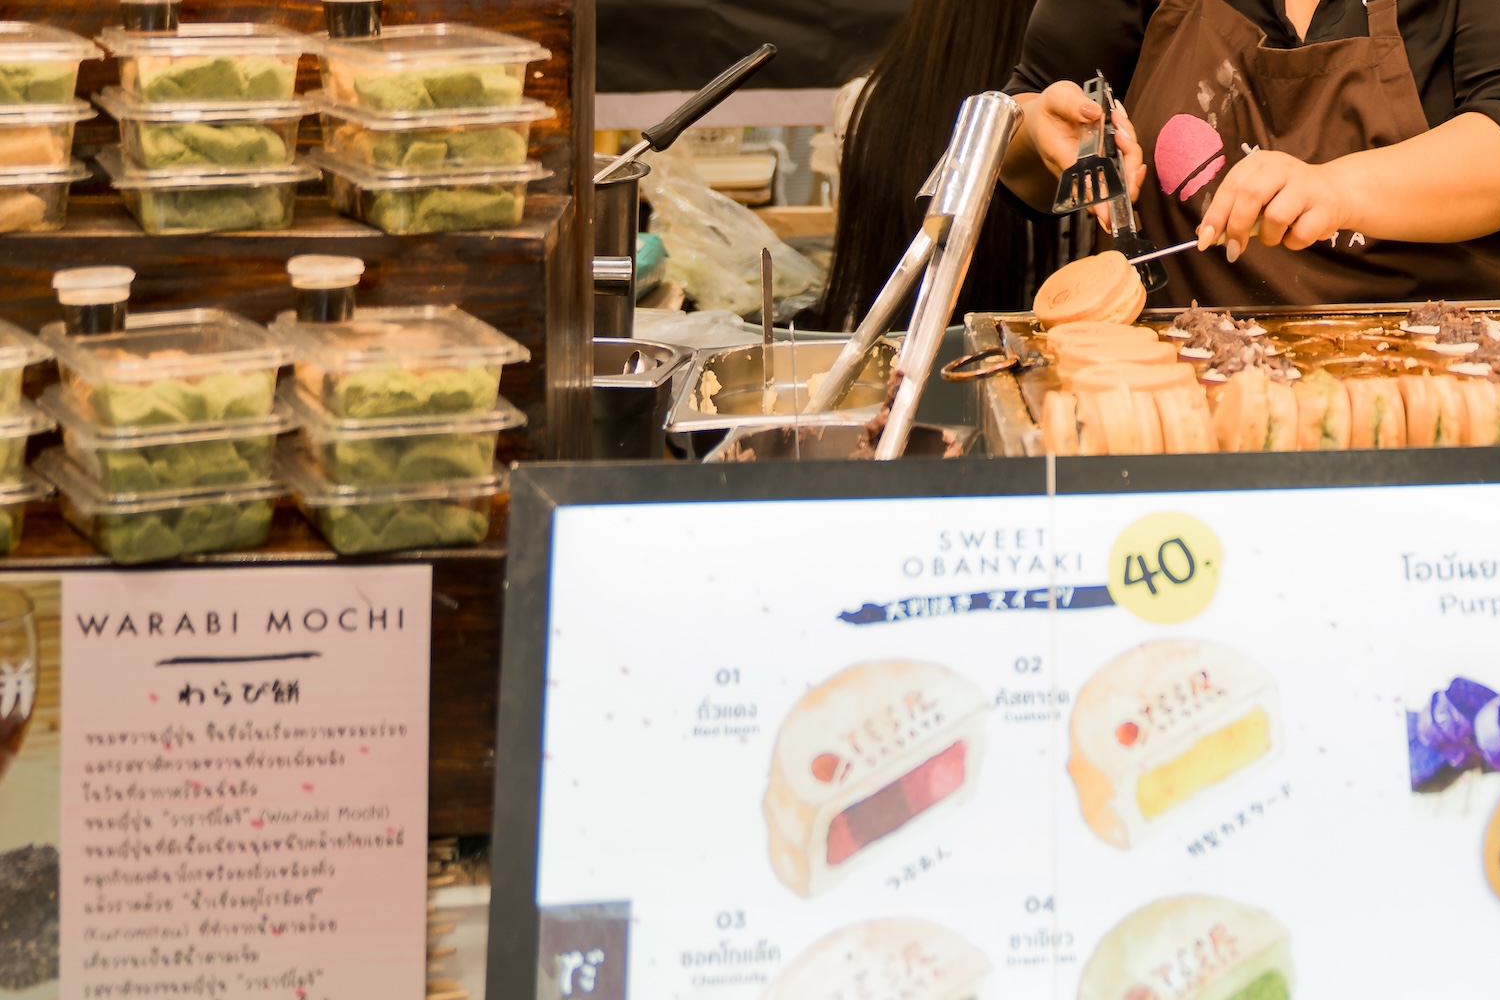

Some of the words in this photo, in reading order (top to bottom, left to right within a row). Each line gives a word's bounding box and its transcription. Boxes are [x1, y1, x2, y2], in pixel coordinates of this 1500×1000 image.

[940, 529, 1046, 550] SWEET
[902, 553, 1083, 578] OBANYAKI
[77, 611, 239, 638] WARABI
[267, 607, 405, 635] MOCHI
[1014, 656, 1043, 674] 02
[716, 911, 746, 930] 03
